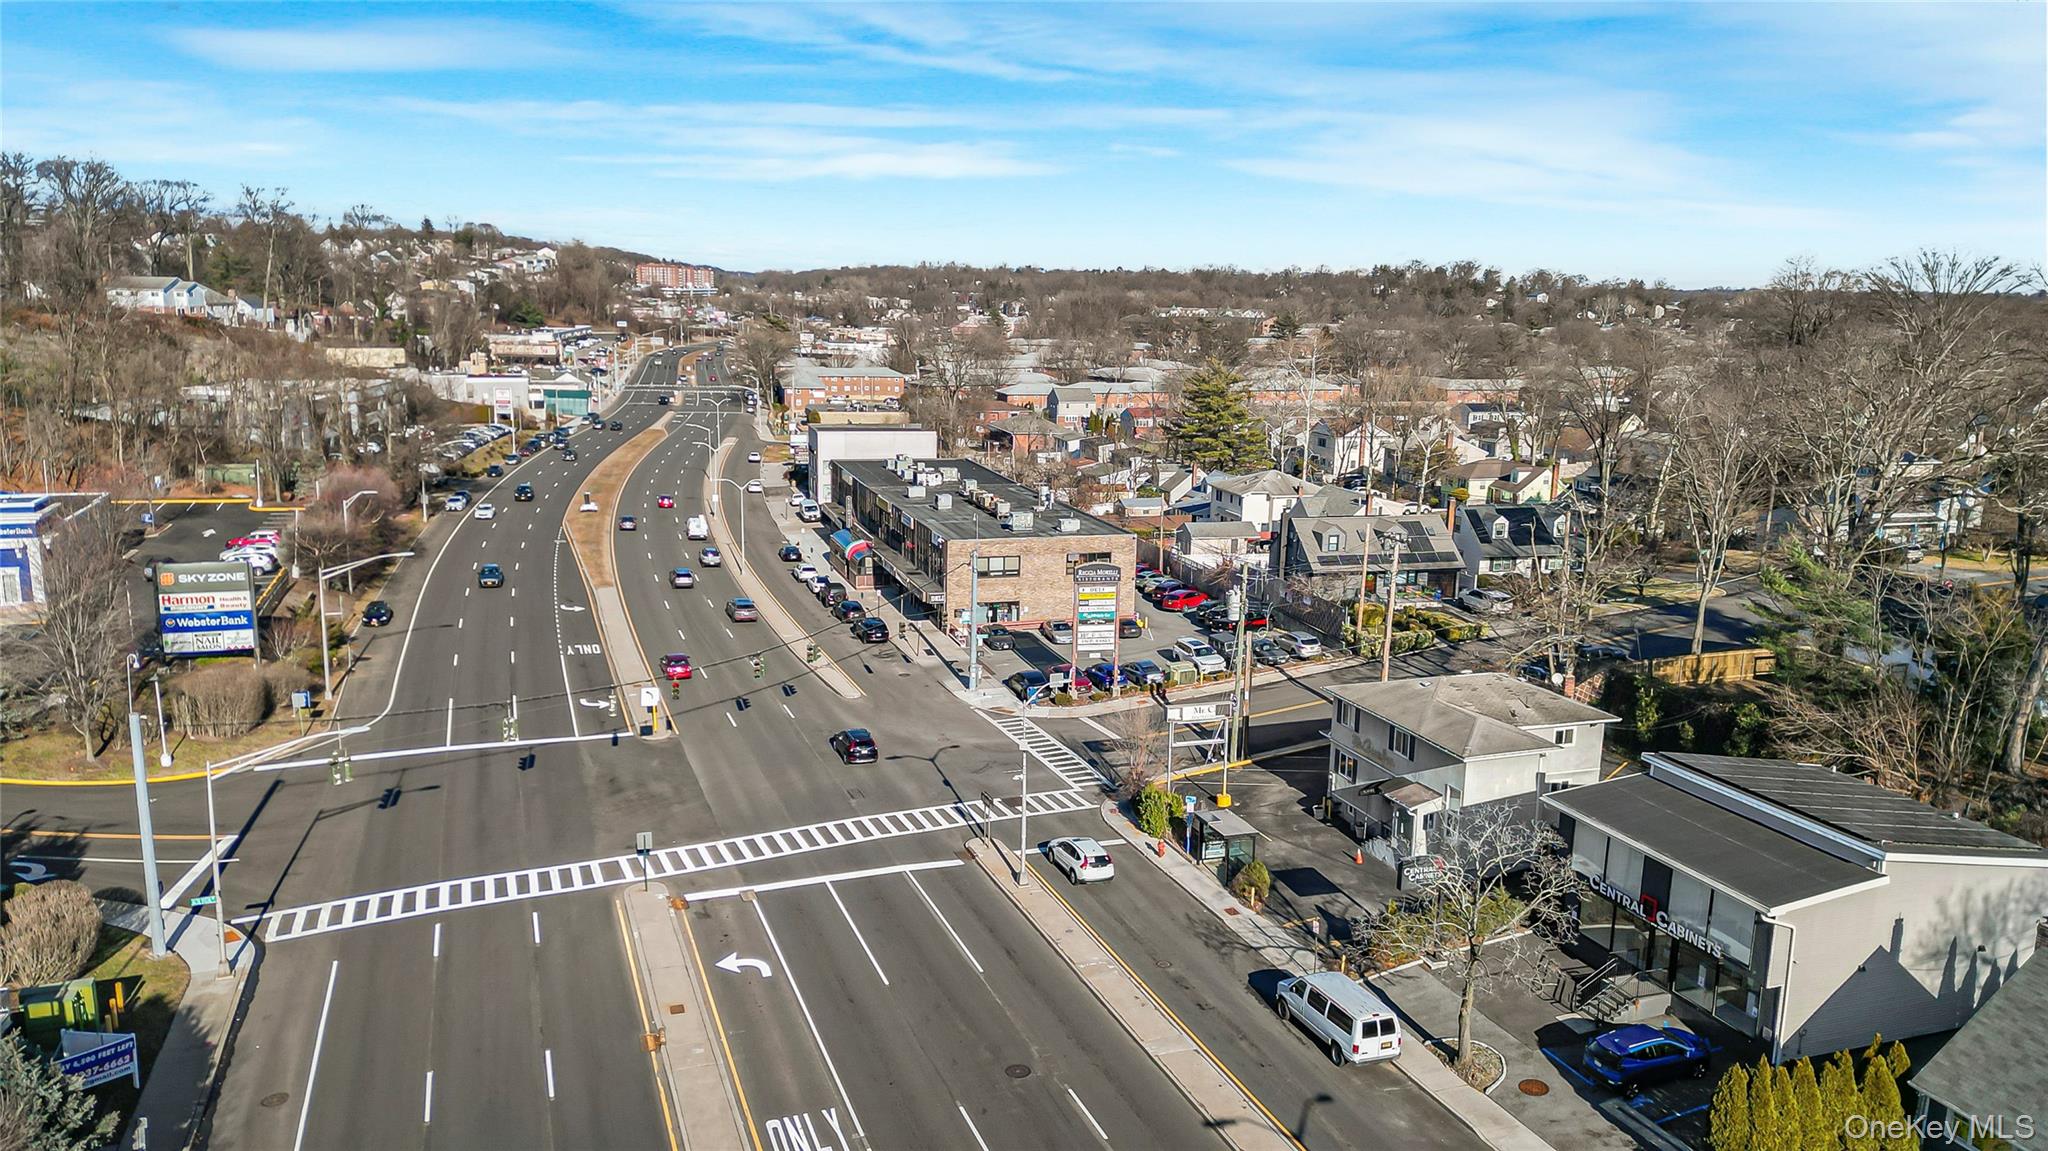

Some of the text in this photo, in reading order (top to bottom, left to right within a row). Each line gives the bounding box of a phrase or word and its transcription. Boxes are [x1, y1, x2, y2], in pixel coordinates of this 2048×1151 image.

[178, 572, 246, 583] SKY ZONE
[161, 595, 215, 606] Harmon
[176, 615, 248, 627] WebsterBank
[196, 636, 220, 644] NAIL
[567, 644, 601, 655] ONLY
[1589, 874, 1722, 959] CENTRAL CABINETS
[97, 1047, 116, 1059] FEET
[117, 1041, 134, 1052] LEFT
[765, 1107, 850, 1151] ONLY
